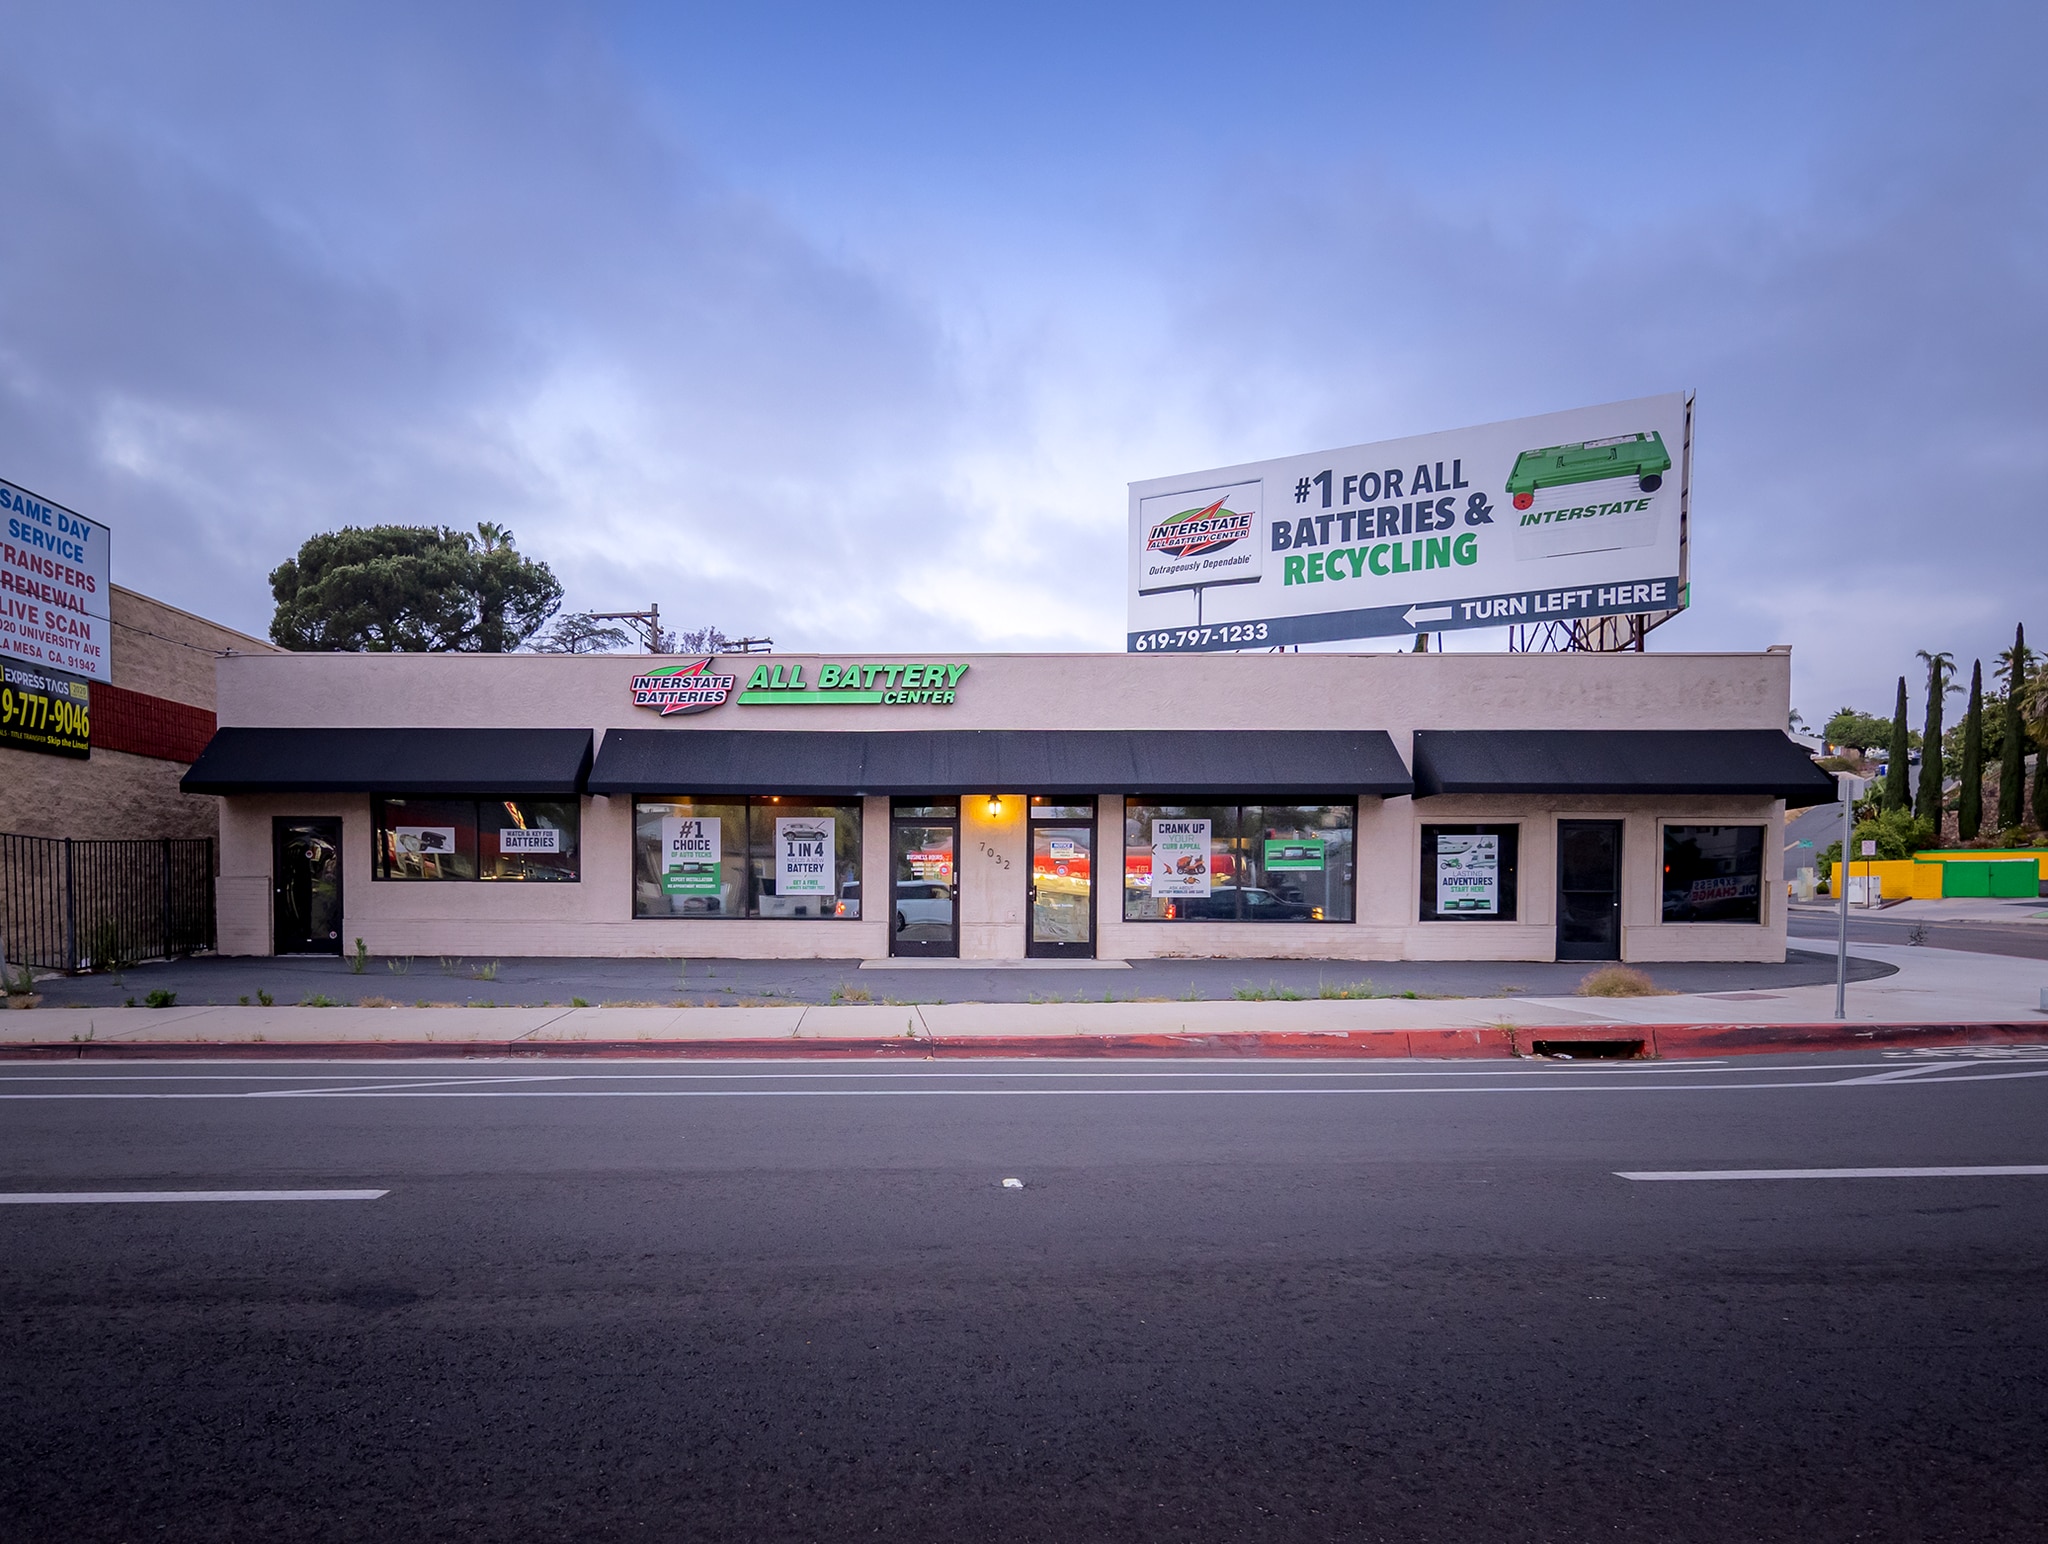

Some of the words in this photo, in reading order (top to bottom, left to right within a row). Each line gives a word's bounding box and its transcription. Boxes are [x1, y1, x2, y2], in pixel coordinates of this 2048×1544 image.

[1294, 469, 1333, 508] #1
[1342, 468, 1404, 506] FOR
[1410, 458, 1469, 496] ALL
[0, 488, 52, 527] SAME
[58, 512, 91, 542] DAY
[1271, 496, 1457, 552] BATTERIES
[1464, 491, 1495, 527] &
[1519, 497, 1654, 527] INTERSTATE
[1149, 541, 1167, 549] ALL
[1168, 533, 1209, 546] BATTERY
[1210, 529, 1247, 541] CENTER
[1151, 514, 1250, 540] INTERSTATE
[8, 518, 84, 564] SERVICE
[1149, 560, 1202, 576] Outrageously
[1283, 532, 1478, 586] RECYCLING
[1, 569, 90, 617] RENEWAL
[1460, 596, 1527, 621] TURN
[1534, 589, 1593, 614] LEFT
[1598, 582, 1667, 607] HERE
[0, 595, 39, 625] LIVE
[44, 610, 91, 641] SCAN
[19, 623, 81, 652] UNIVERSITY
[83, 643, 101, 658] AVE
[1135, 622, 1269, 651] 619-797-1233
[13, 640, 43, 659] MESA
[48, 650, 66, 665] CA.
[68, 655, 96, 673] 91942
[4, 667, 46, 691] EXPRESS
[46, 677, 70, 696] TAGS
[633, 676, 732, 690] INTERSTATE
[746, 664, 807, 689] ALL
[818, 663, 969, 689] BATTERY
[636, 690, 725, 703] BATTERIES
[884, 690, 956, 705] CENTER
[2, 687, 90, 739] 9-777-9046
[47, 735, 61, 747] Skip
[62, 737, 72, 748] the
[679, 820, 704, 838] #1
[1158, 823, 1190, 834] CRANK
[1192, 823, 1205, 834] UP
[1169, 834, 1195, 843] YOUR
[506, 837, 554, 847] BATTERIES
[673, 839, 711, 851] CHOICE
[787, 842, 796, 857] 1
[798, 842, 811, 857] IN
[814, 842, 824, 857] 4
[787, 863, 825, 873] BATTERY
[1442, 877, 1493, 886] ADVENTURES
